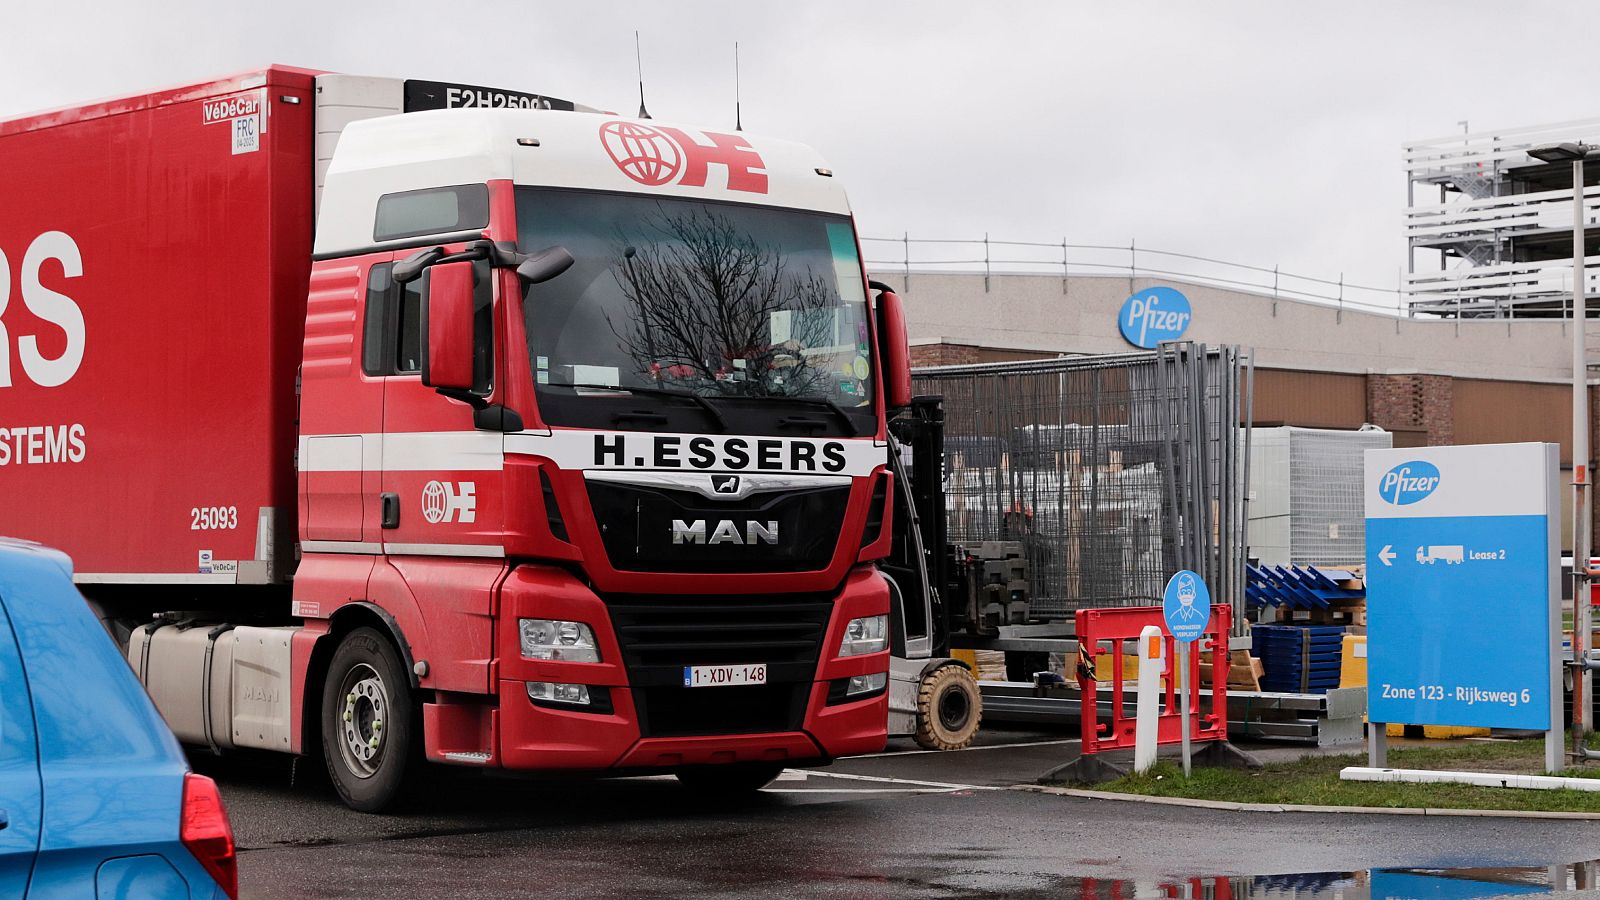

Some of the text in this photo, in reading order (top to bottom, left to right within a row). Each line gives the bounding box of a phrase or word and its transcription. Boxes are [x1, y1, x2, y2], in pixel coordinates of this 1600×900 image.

[204, 98, 258, 120] VéDéCar
[237, 117, 254, 137] FRC
[0, 230, 86, 387] S
[1128, 295, 1189, 347] Pfizer
[0, 423, 86, 466] STEMS
[1384, 467, 1439, 505] Pfizer
[190, 506, 238, 530] 25093
[672, 519, 779, 545] MAN
[1469, 550, 1506, 560] Lease 2
[1382, 684, 1416, 699] Zone
[1419, 686, 1444, 700] 123
[1456, 687, 1517, 707] Rijksweg
[1521, 689, 1530, 703] 6
